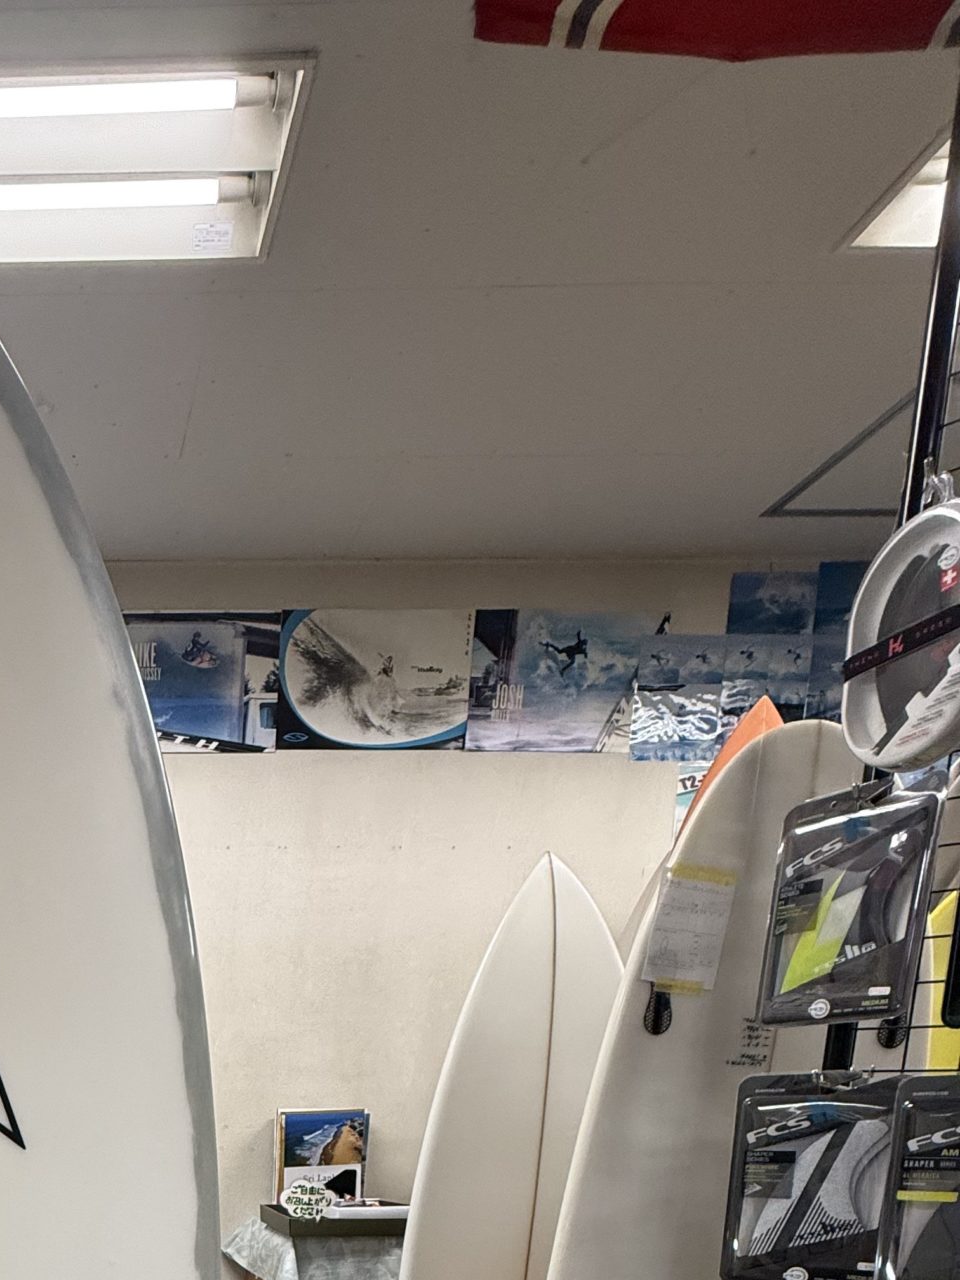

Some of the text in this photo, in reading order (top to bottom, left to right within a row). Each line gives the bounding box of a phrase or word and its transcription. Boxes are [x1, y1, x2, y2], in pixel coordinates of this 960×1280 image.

[492, 682, 525, 710] JOSH
[785, 836, 844, 879] FCS
[746, 1115, 811, 1144] FCS
[291, 1184, 326, 1196] ご自由に
